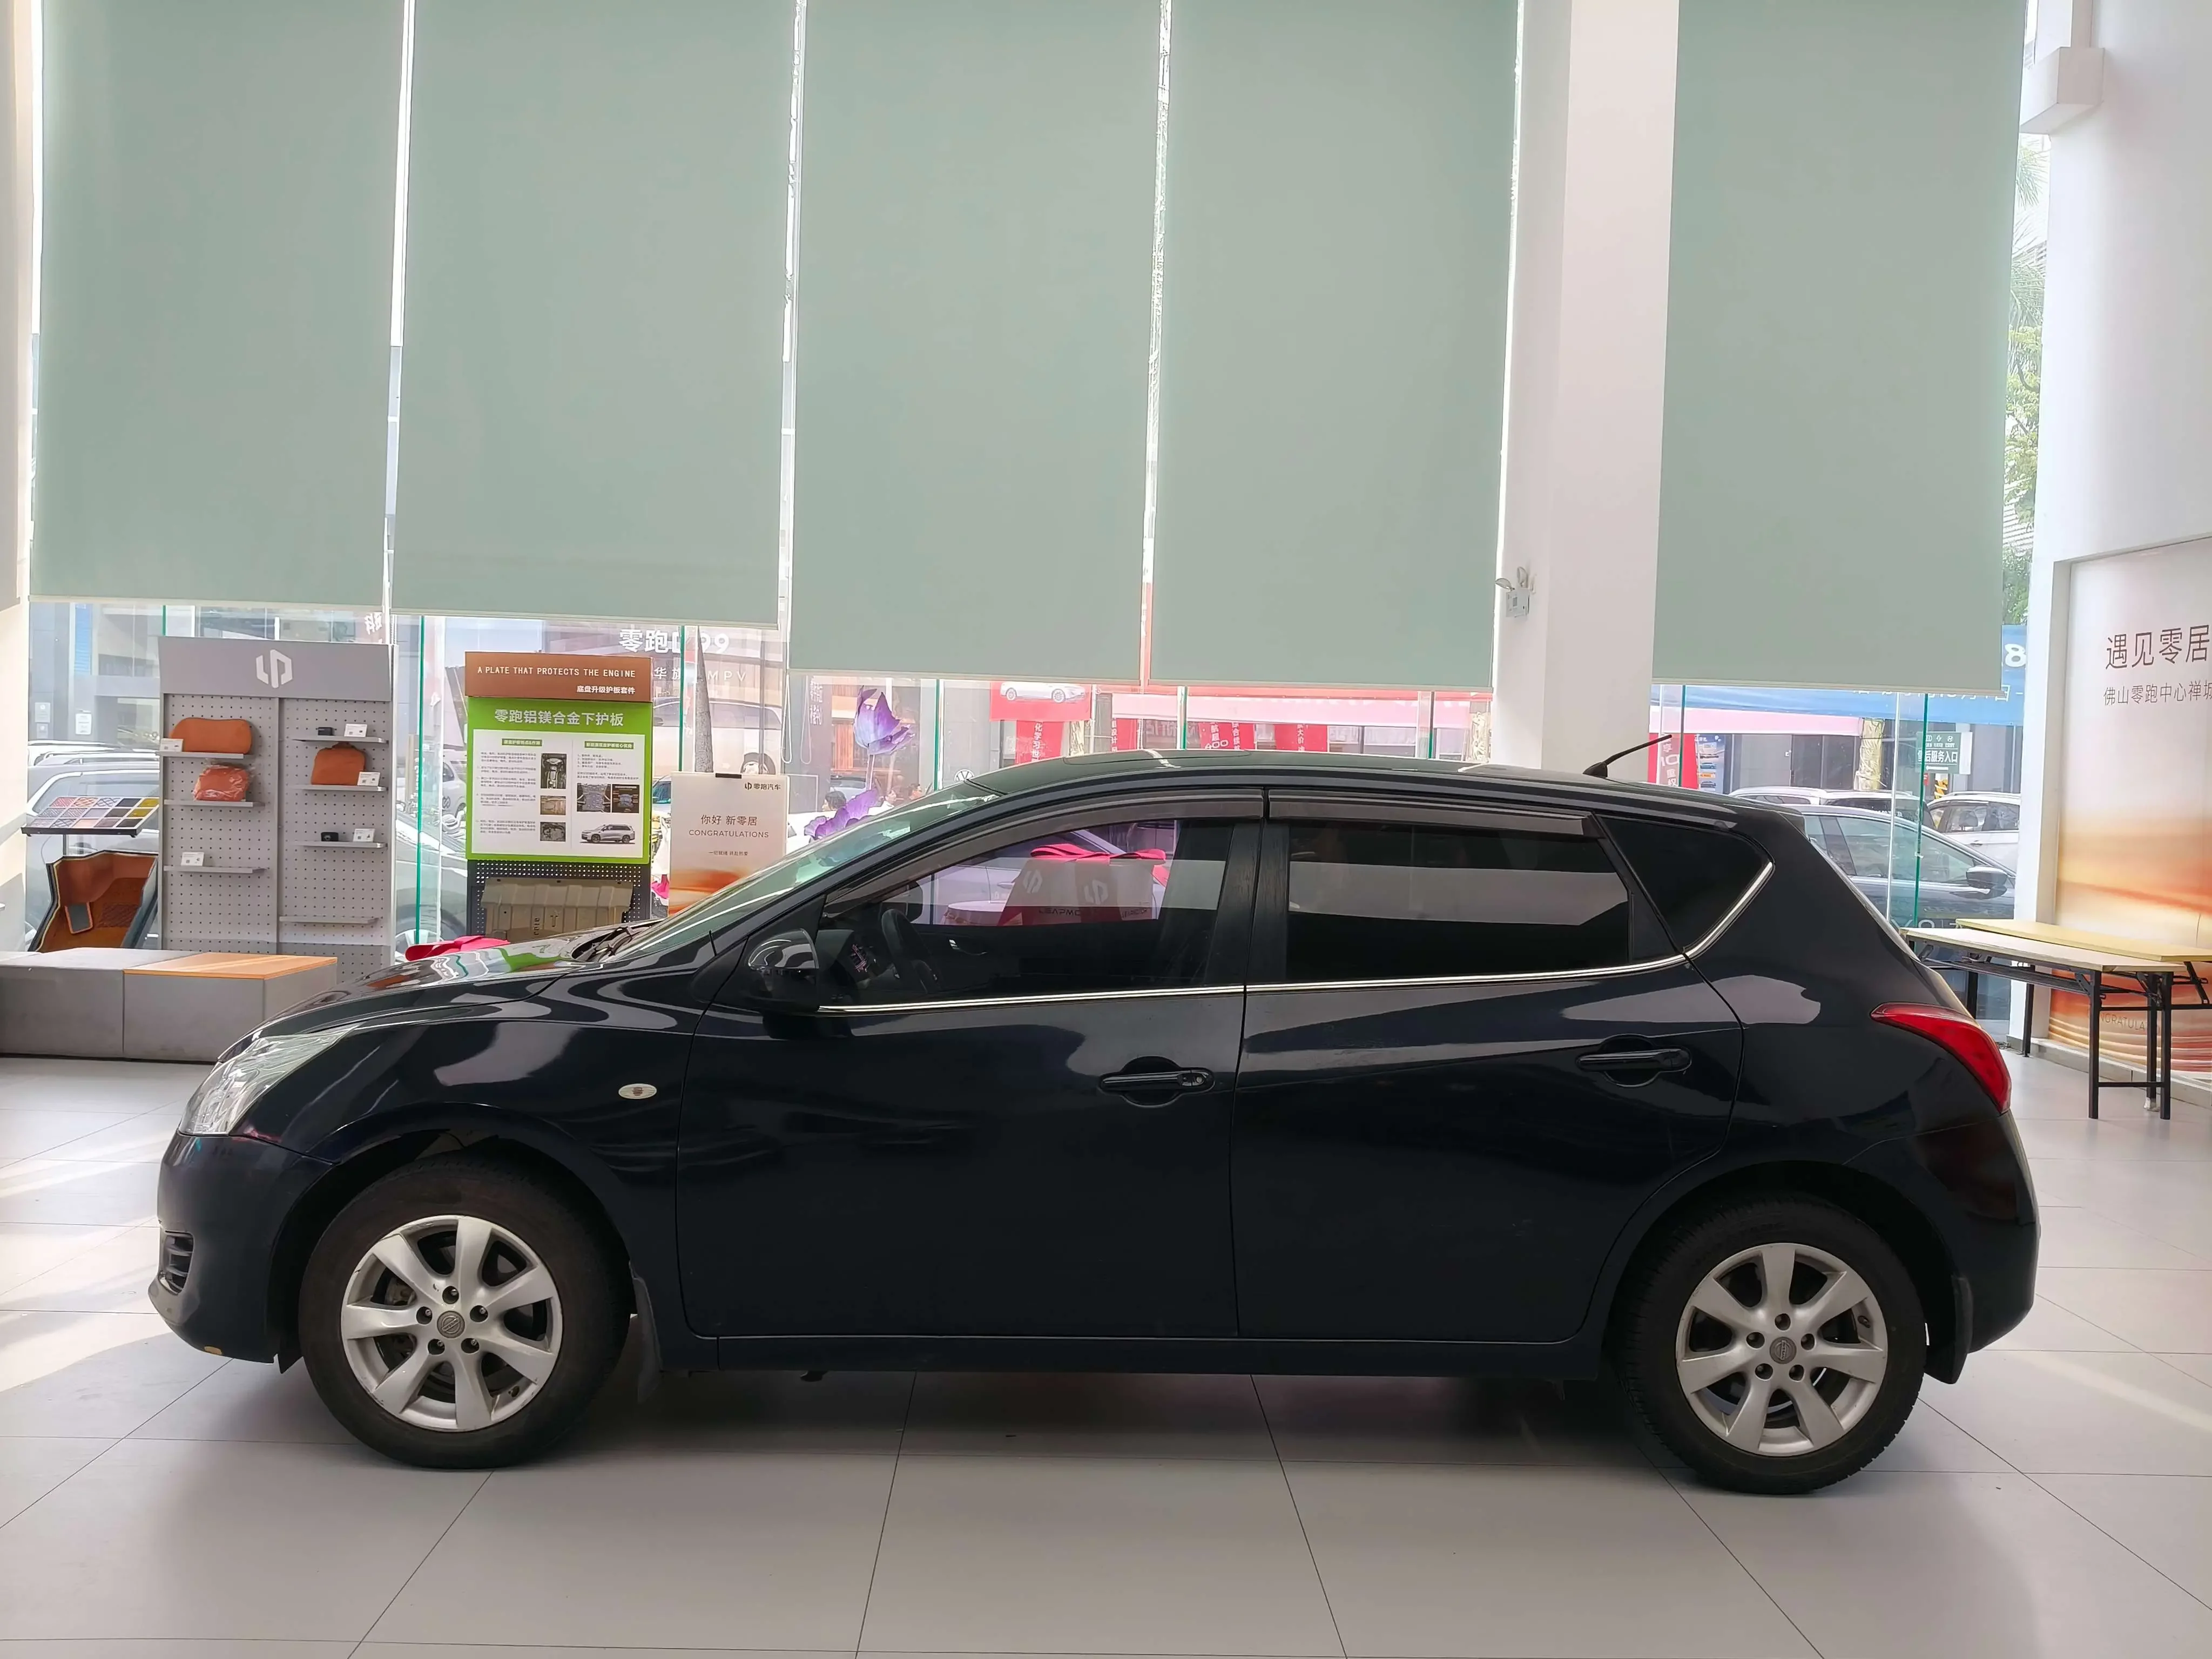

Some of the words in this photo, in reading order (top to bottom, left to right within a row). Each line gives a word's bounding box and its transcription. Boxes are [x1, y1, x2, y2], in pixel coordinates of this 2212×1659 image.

[2105, 624, 2210, 670] 遇见零居
[603, 670, 636, 678] ENGINE
[577, 685, 636, 694] 底盘升级护板套件
[2103, 679, 2212, 706] 佛山零跑中心禅城
[494, 709, 624, 727] 零跑铝镁合金下护板
[700, 814, 722, 825] 你好
[726, 815, 758, 826] 新零居
[689, 830, 769, 838] CONGRATULATIONS
